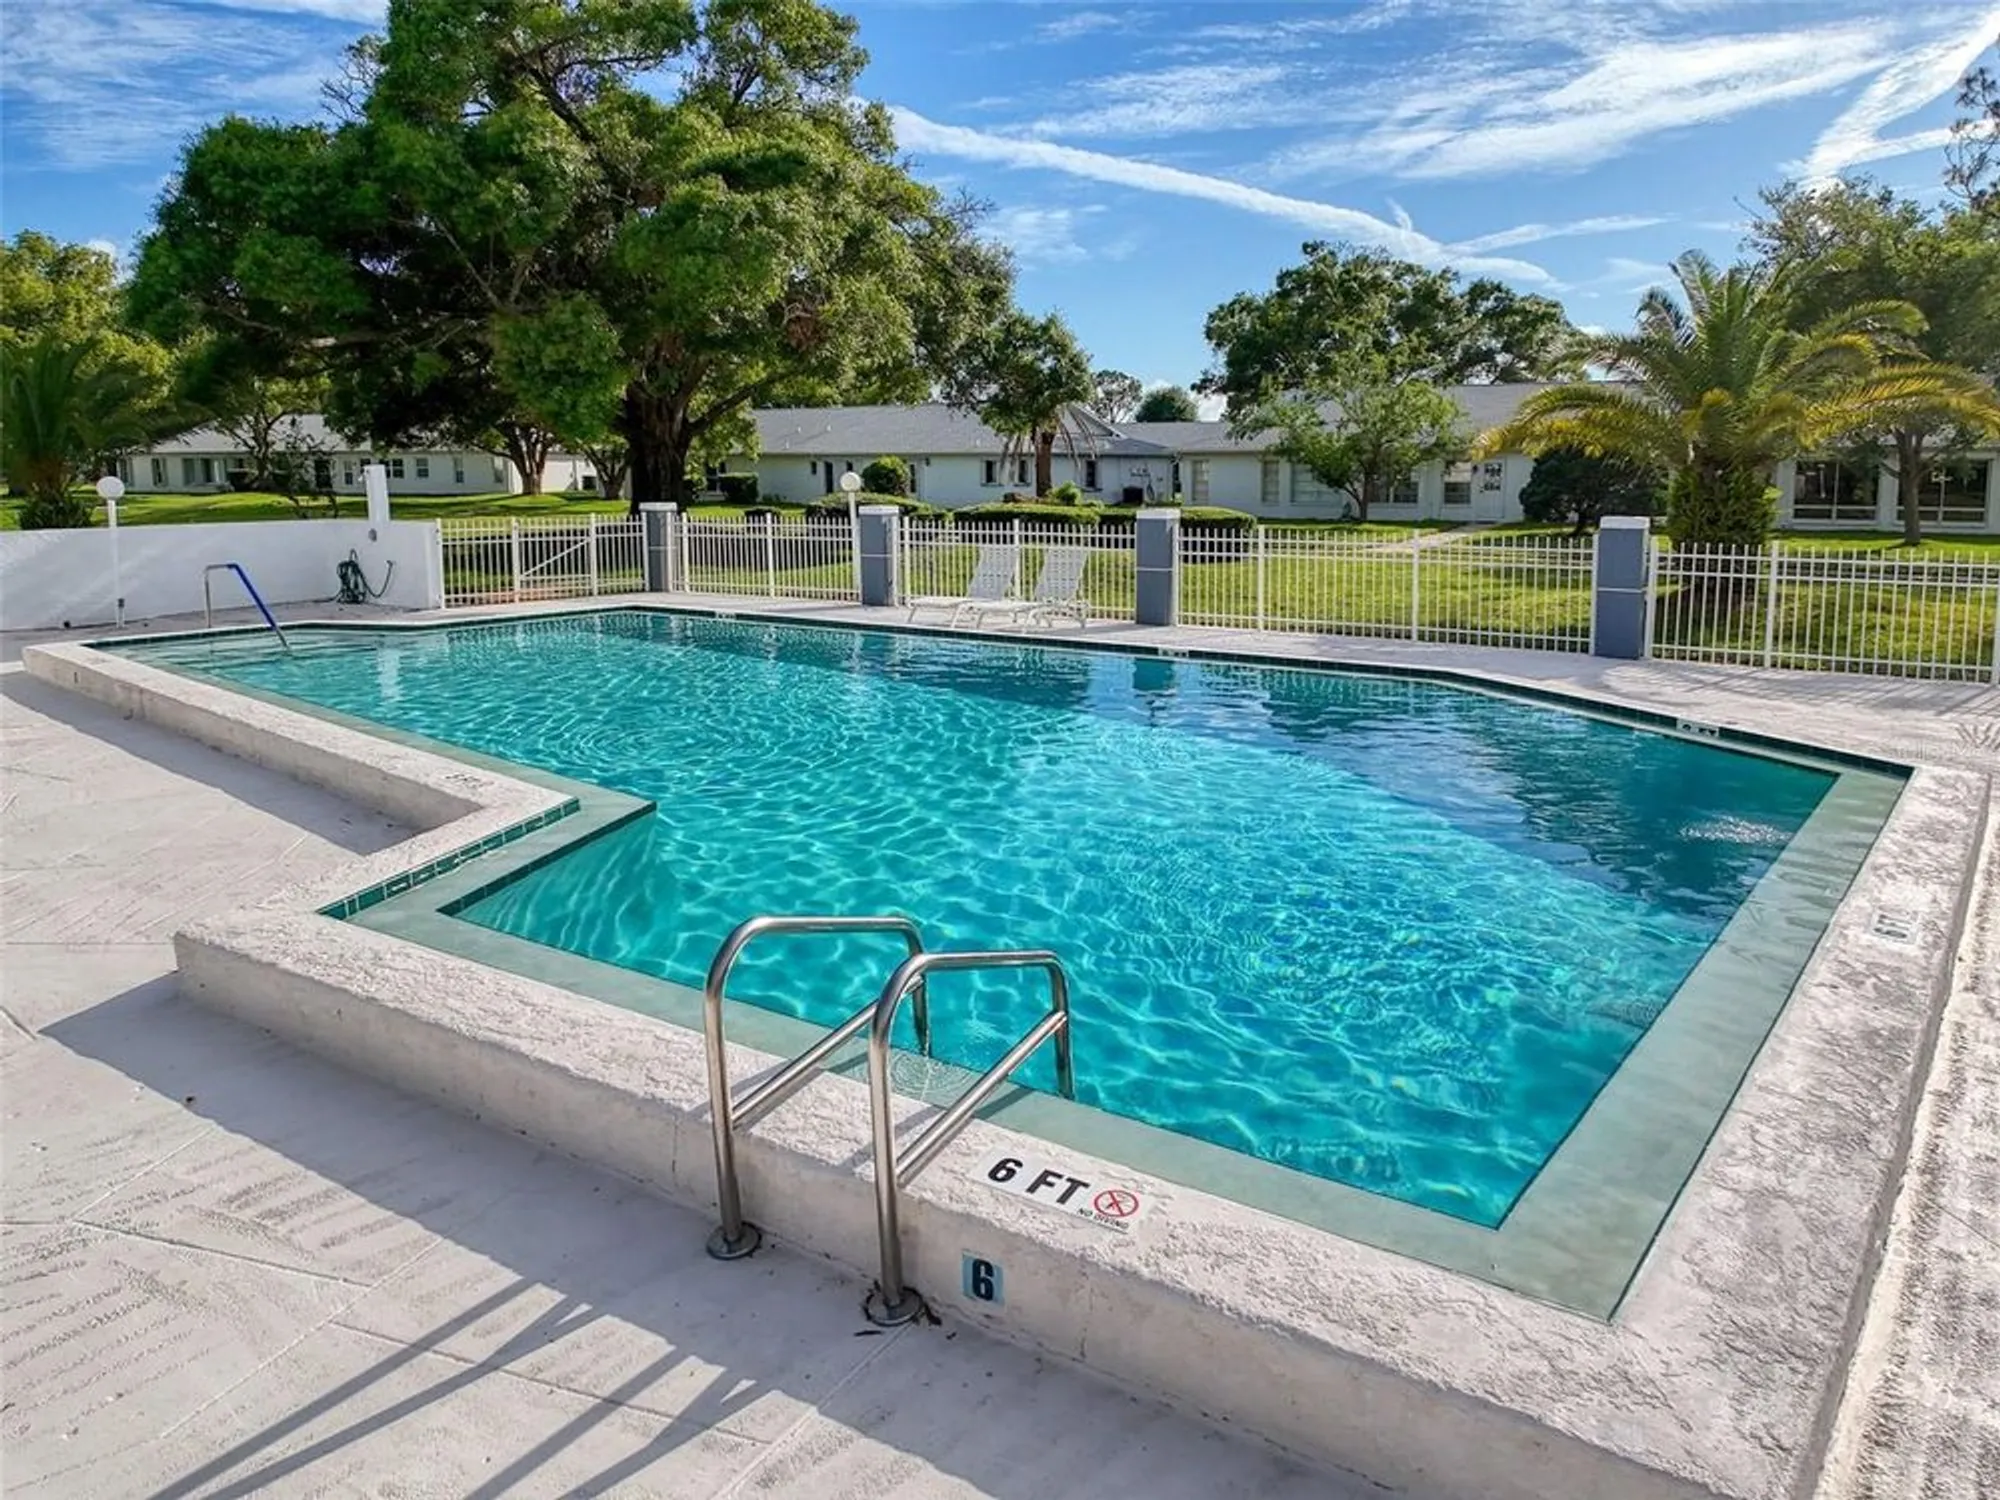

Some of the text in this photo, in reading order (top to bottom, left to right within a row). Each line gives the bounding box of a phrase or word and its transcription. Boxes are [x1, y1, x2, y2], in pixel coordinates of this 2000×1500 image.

[987, 1157, 1091, 1206] 6 FT
[1078, 1208, 1129, 1230] NO DIVING
[971, 1258, 995, 1302] 6
